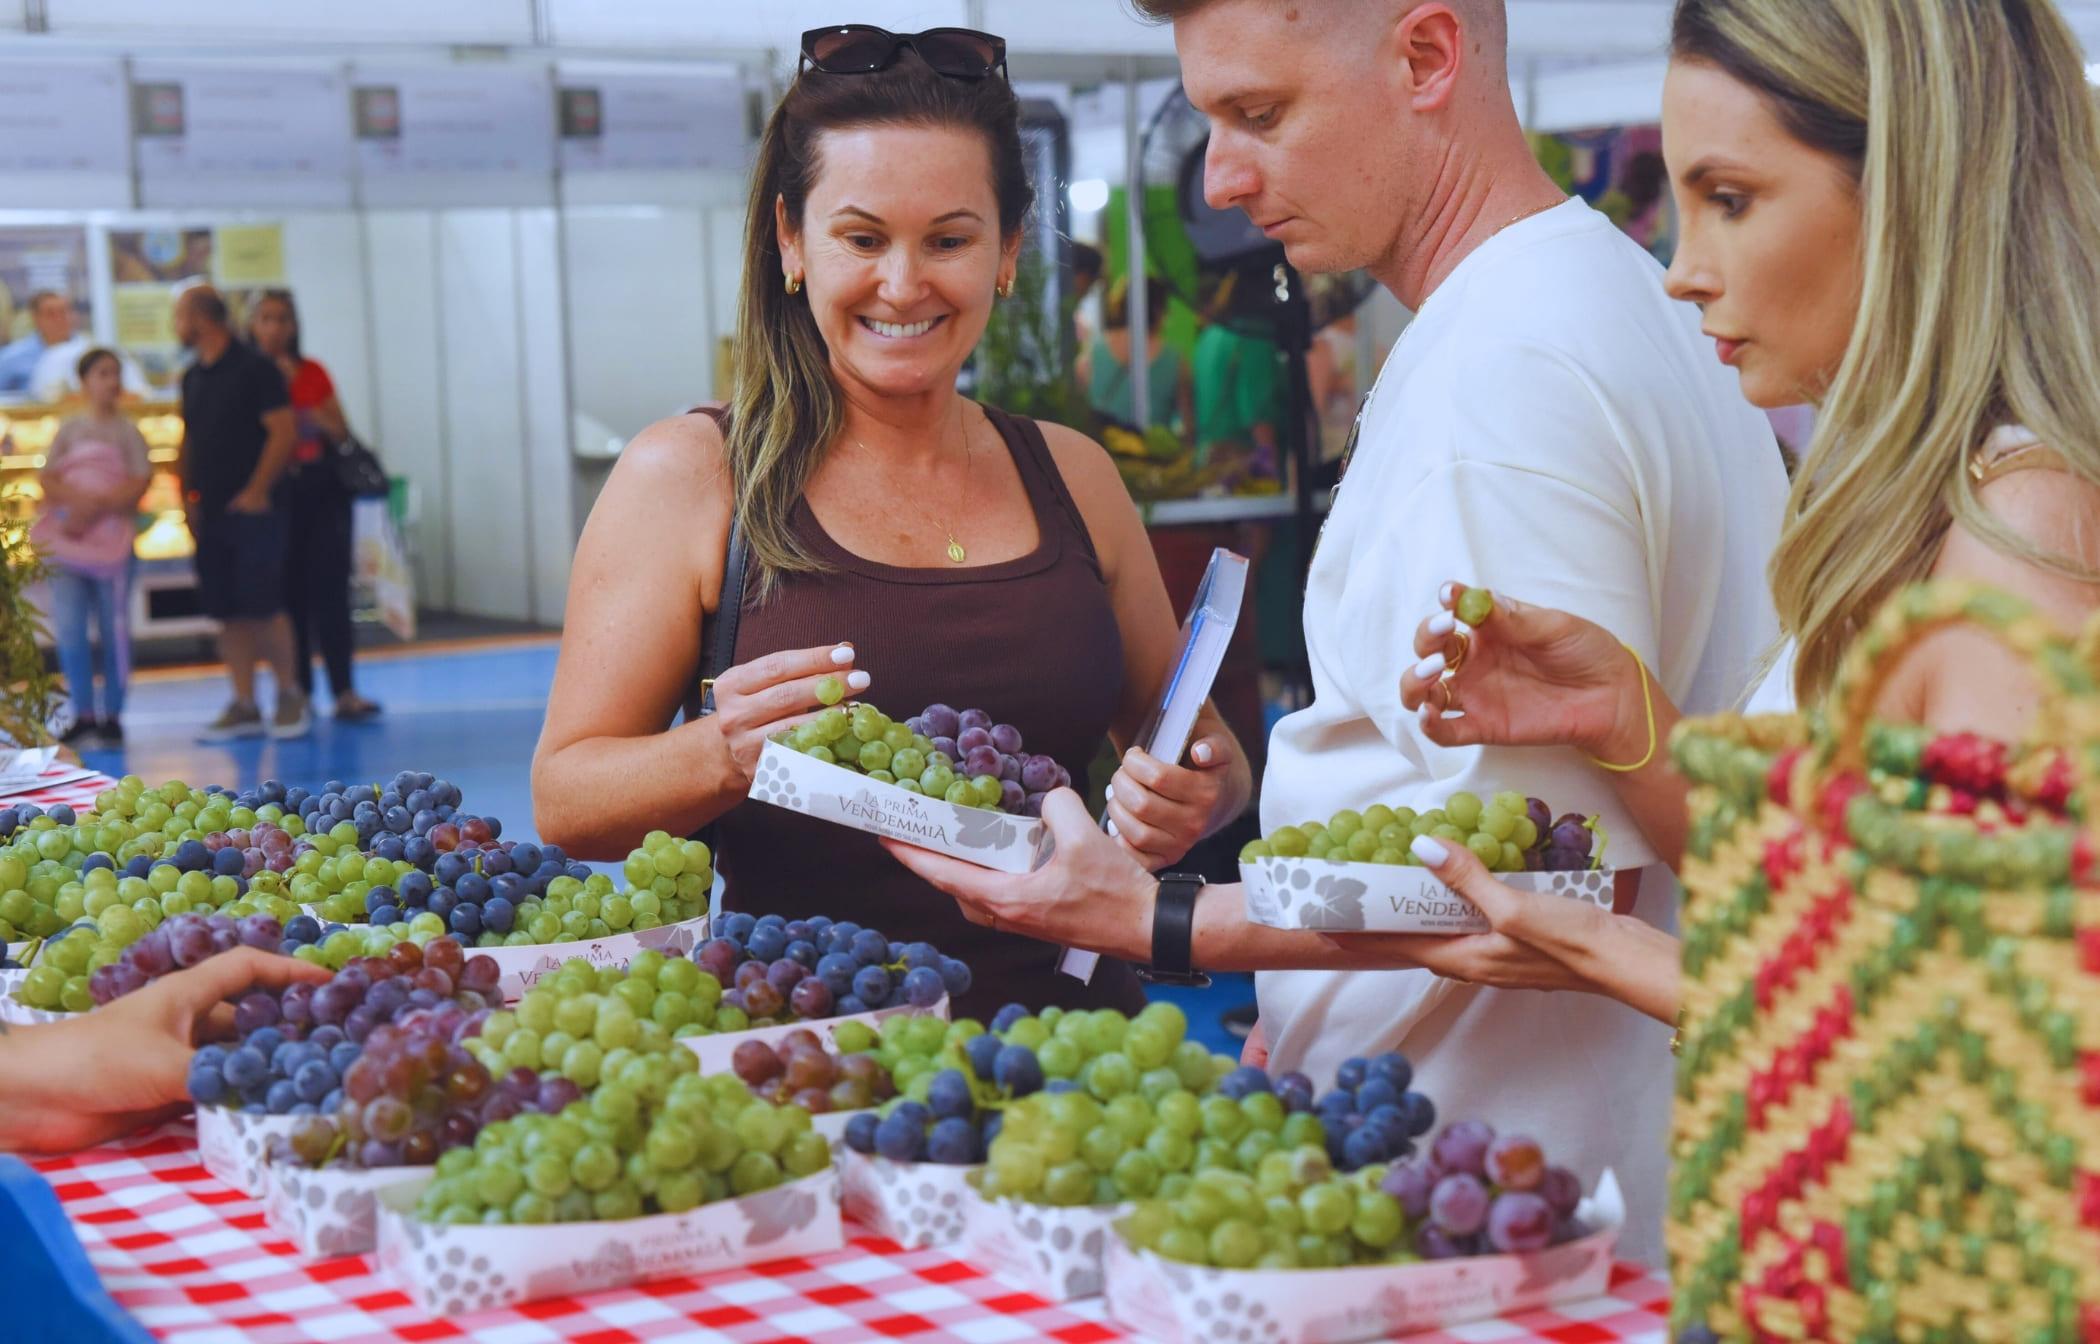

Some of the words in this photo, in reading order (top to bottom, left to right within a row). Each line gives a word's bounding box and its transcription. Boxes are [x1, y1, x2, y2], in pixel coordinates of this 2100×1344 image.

[863, 791, 879, 808] LA
[884, 799, 929, 821] PRIMA
[838, 795, 951, 847] VENDEMMIA
[1420, 881, 1438, 900] LA
[1389, 895, 1483, 917] VENDEM
